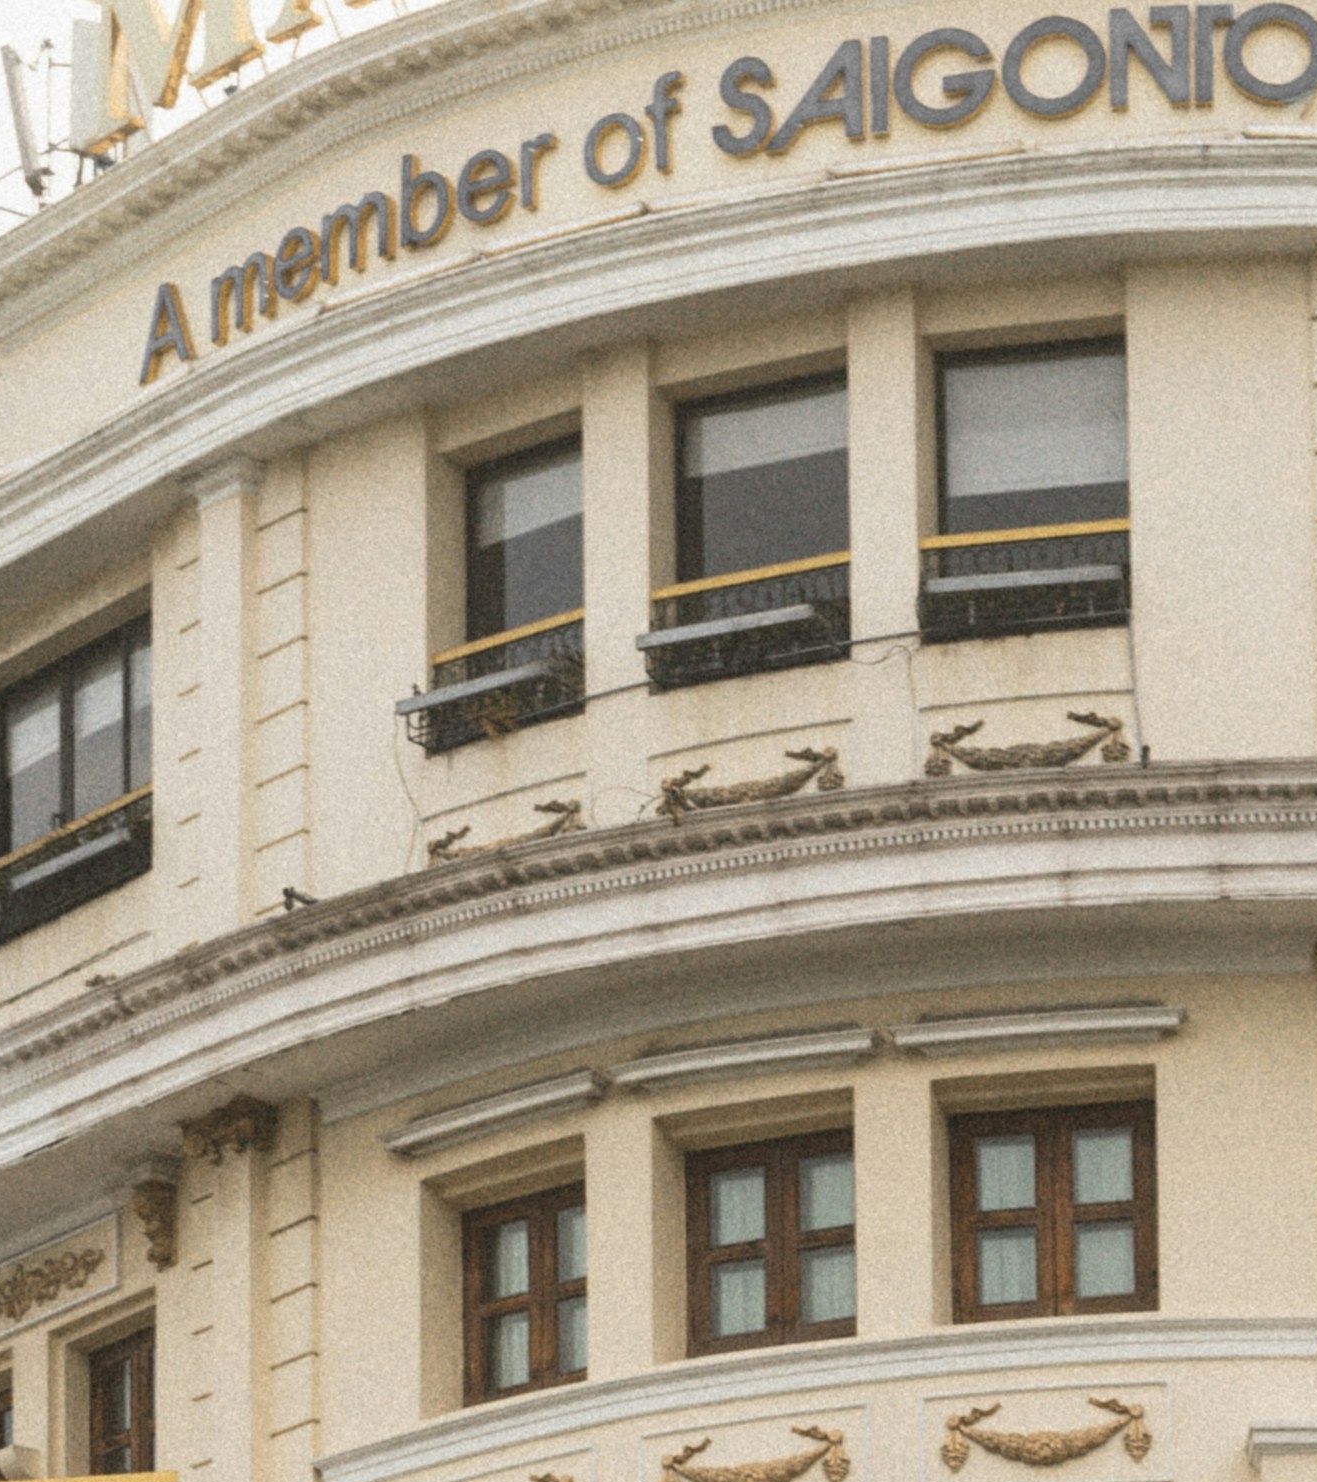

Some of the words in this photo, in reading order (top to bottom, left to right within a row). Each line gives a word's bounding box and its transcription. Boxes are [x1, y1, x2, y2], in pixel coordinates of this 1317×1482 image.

[139, 282, 197, 386] A
[211, 132, 559, 346] member
[583, 70, 686, 188] of
